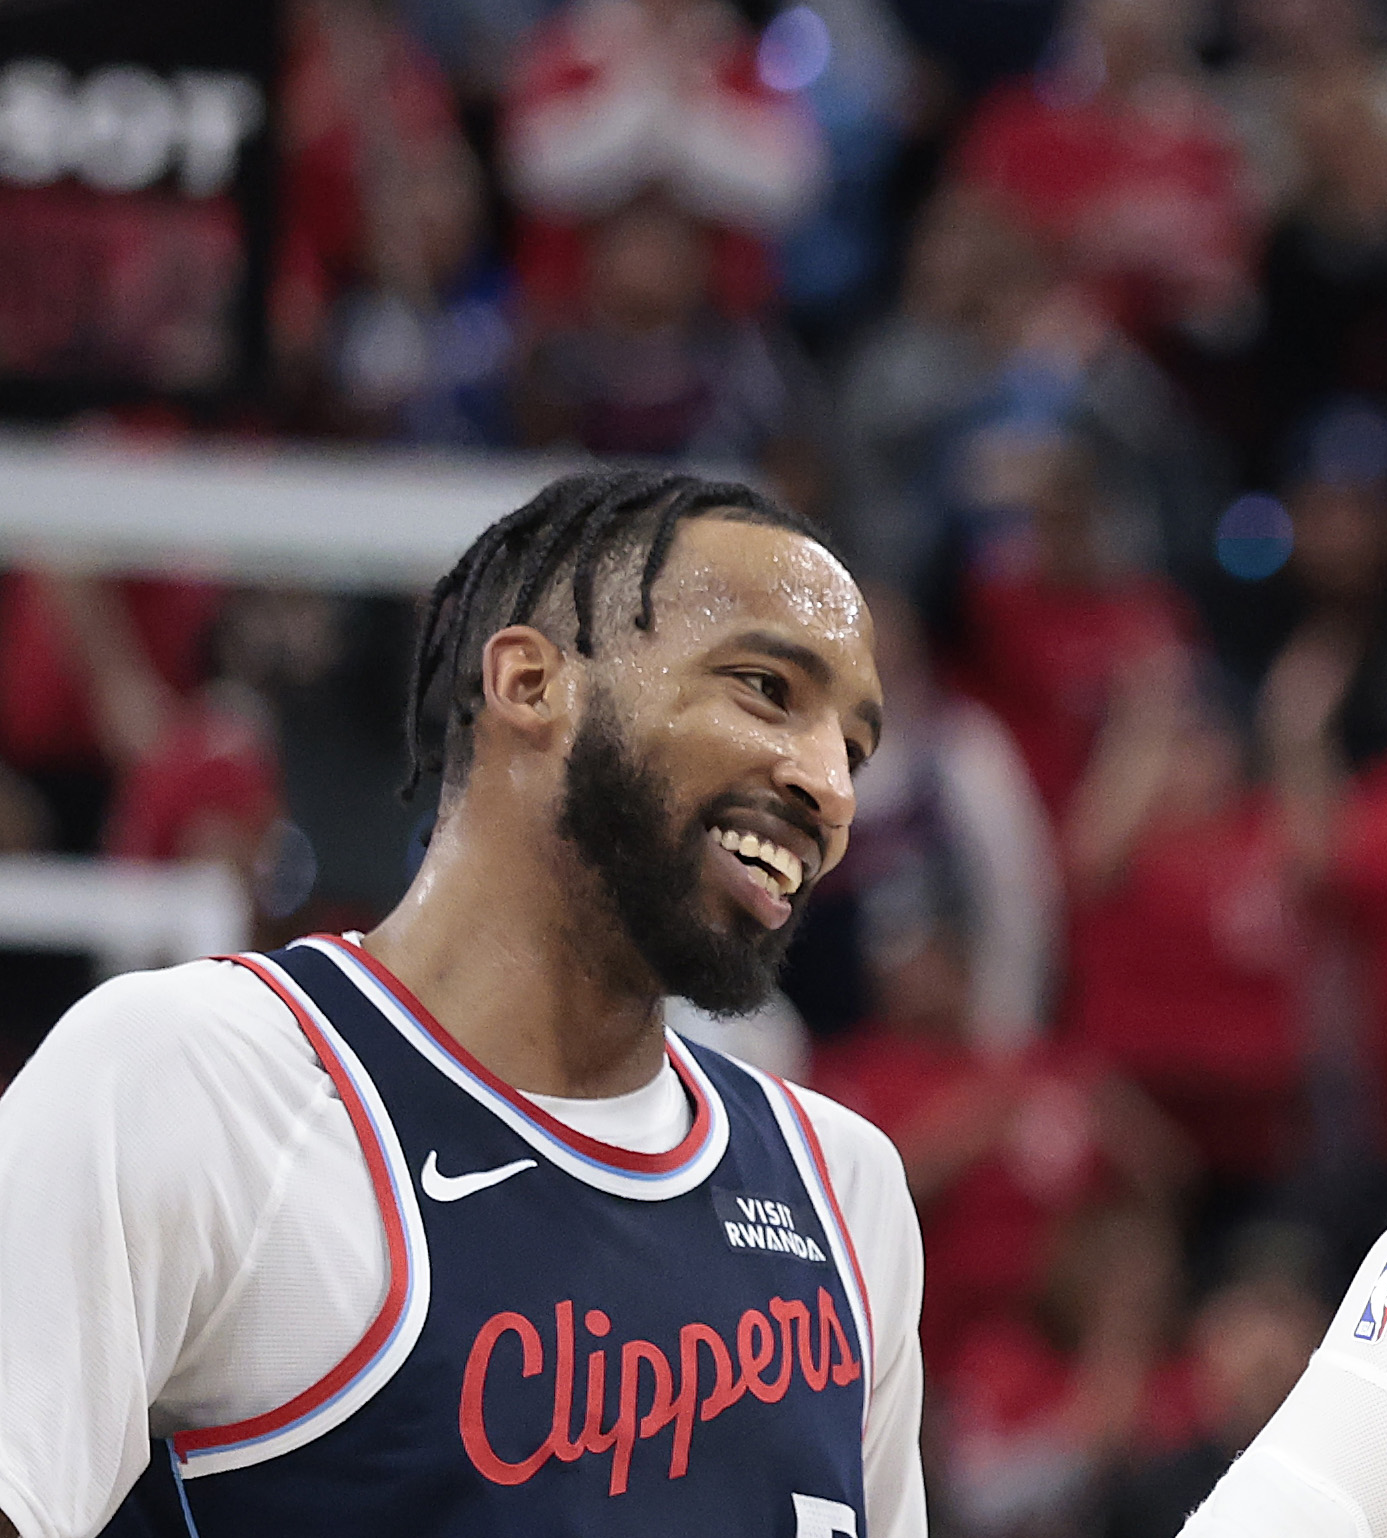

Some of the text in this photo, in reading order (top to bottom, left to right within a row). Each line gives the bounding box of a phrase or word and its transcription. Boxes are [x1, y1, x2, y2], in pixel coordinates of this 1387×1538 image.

[736, 1196, 795, 1230] VISIT
[724, 1221, 826, 1262] RWANDA
[459, 1286, 860, 1496] Clippers
